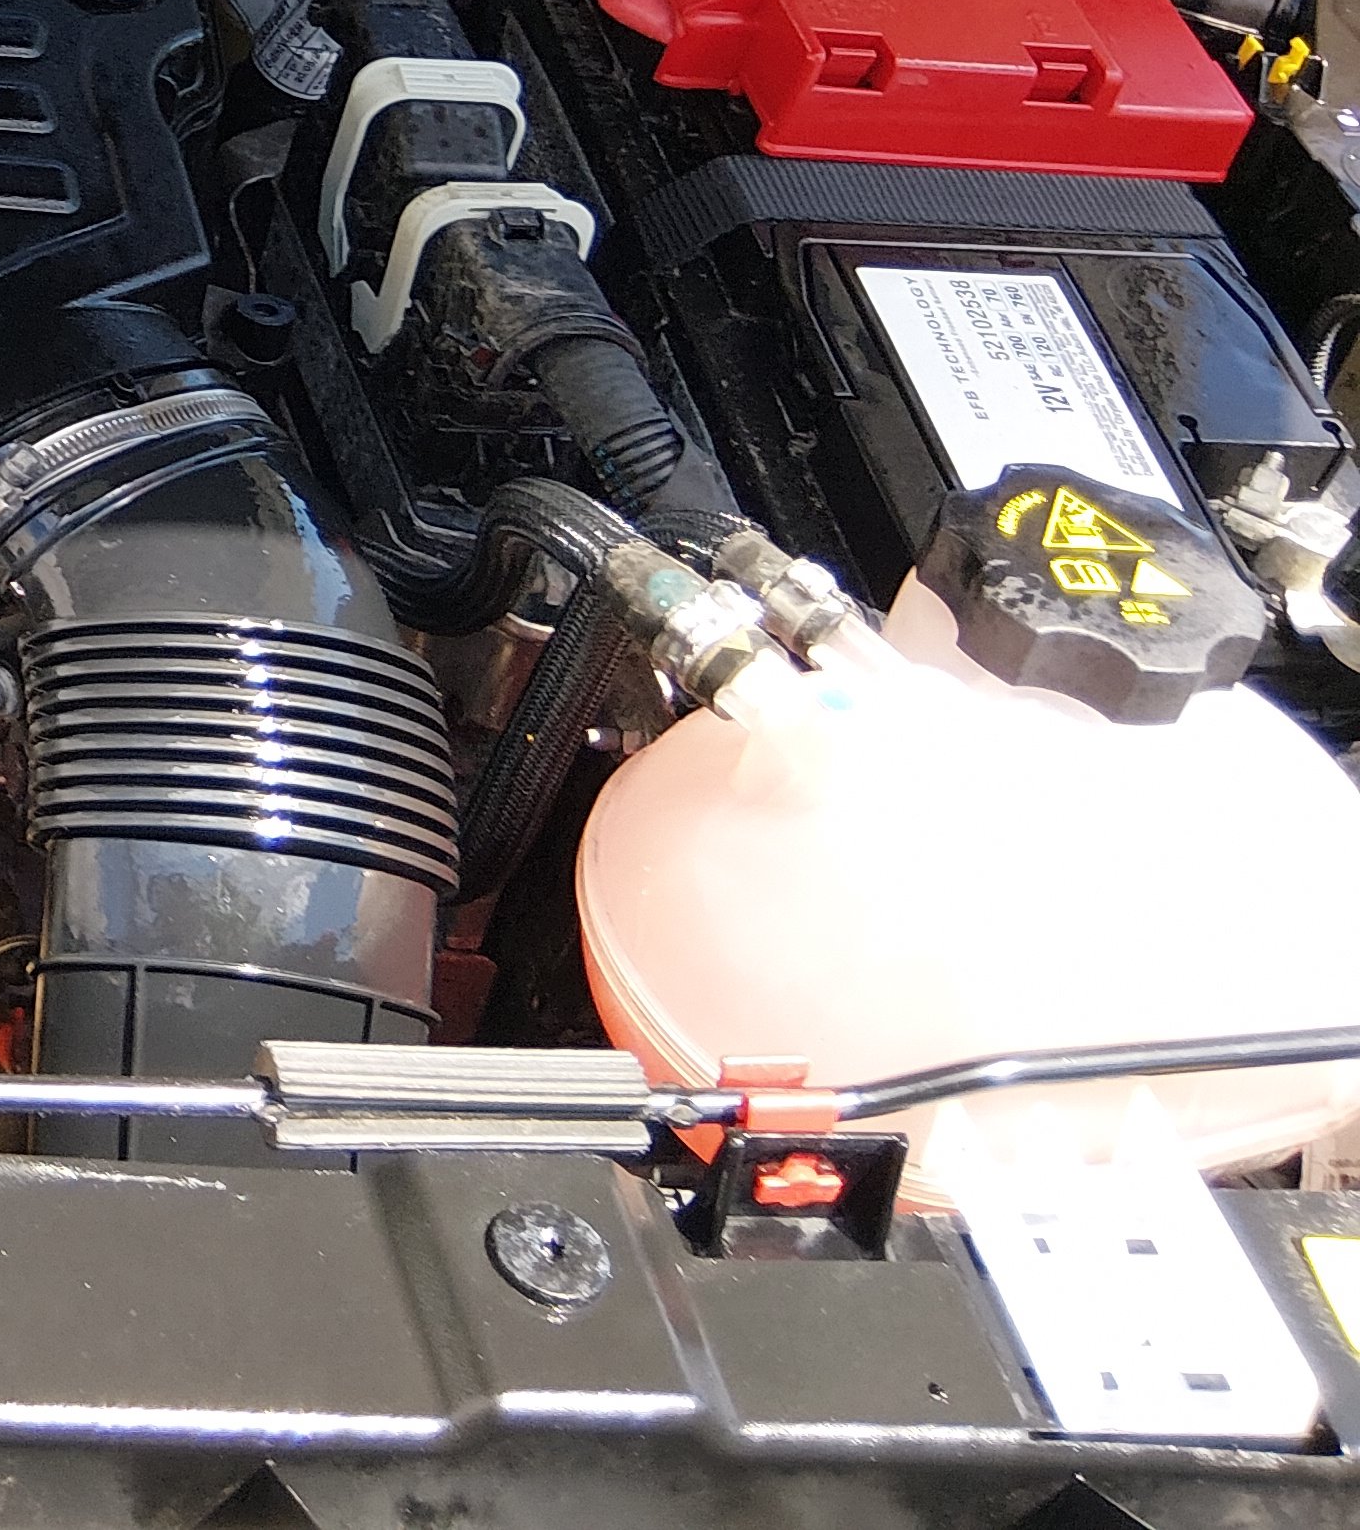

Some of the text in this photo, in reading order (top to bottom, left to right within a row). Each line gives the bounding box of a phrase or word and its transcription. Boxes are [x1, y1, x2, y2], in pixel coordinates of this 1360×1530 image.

[982, 288, 1001, 303] 70
[1005, 285, 1028, 308] 760
[948, 279, 1011, 361] 52102538
[903, 276, 990, 421] EFB TECHNOLOGY
[1008, 335, 1031, 358] 700
[1033, 336, 1056, 358] 120
[1032, 382, 1075, 413] 12V
